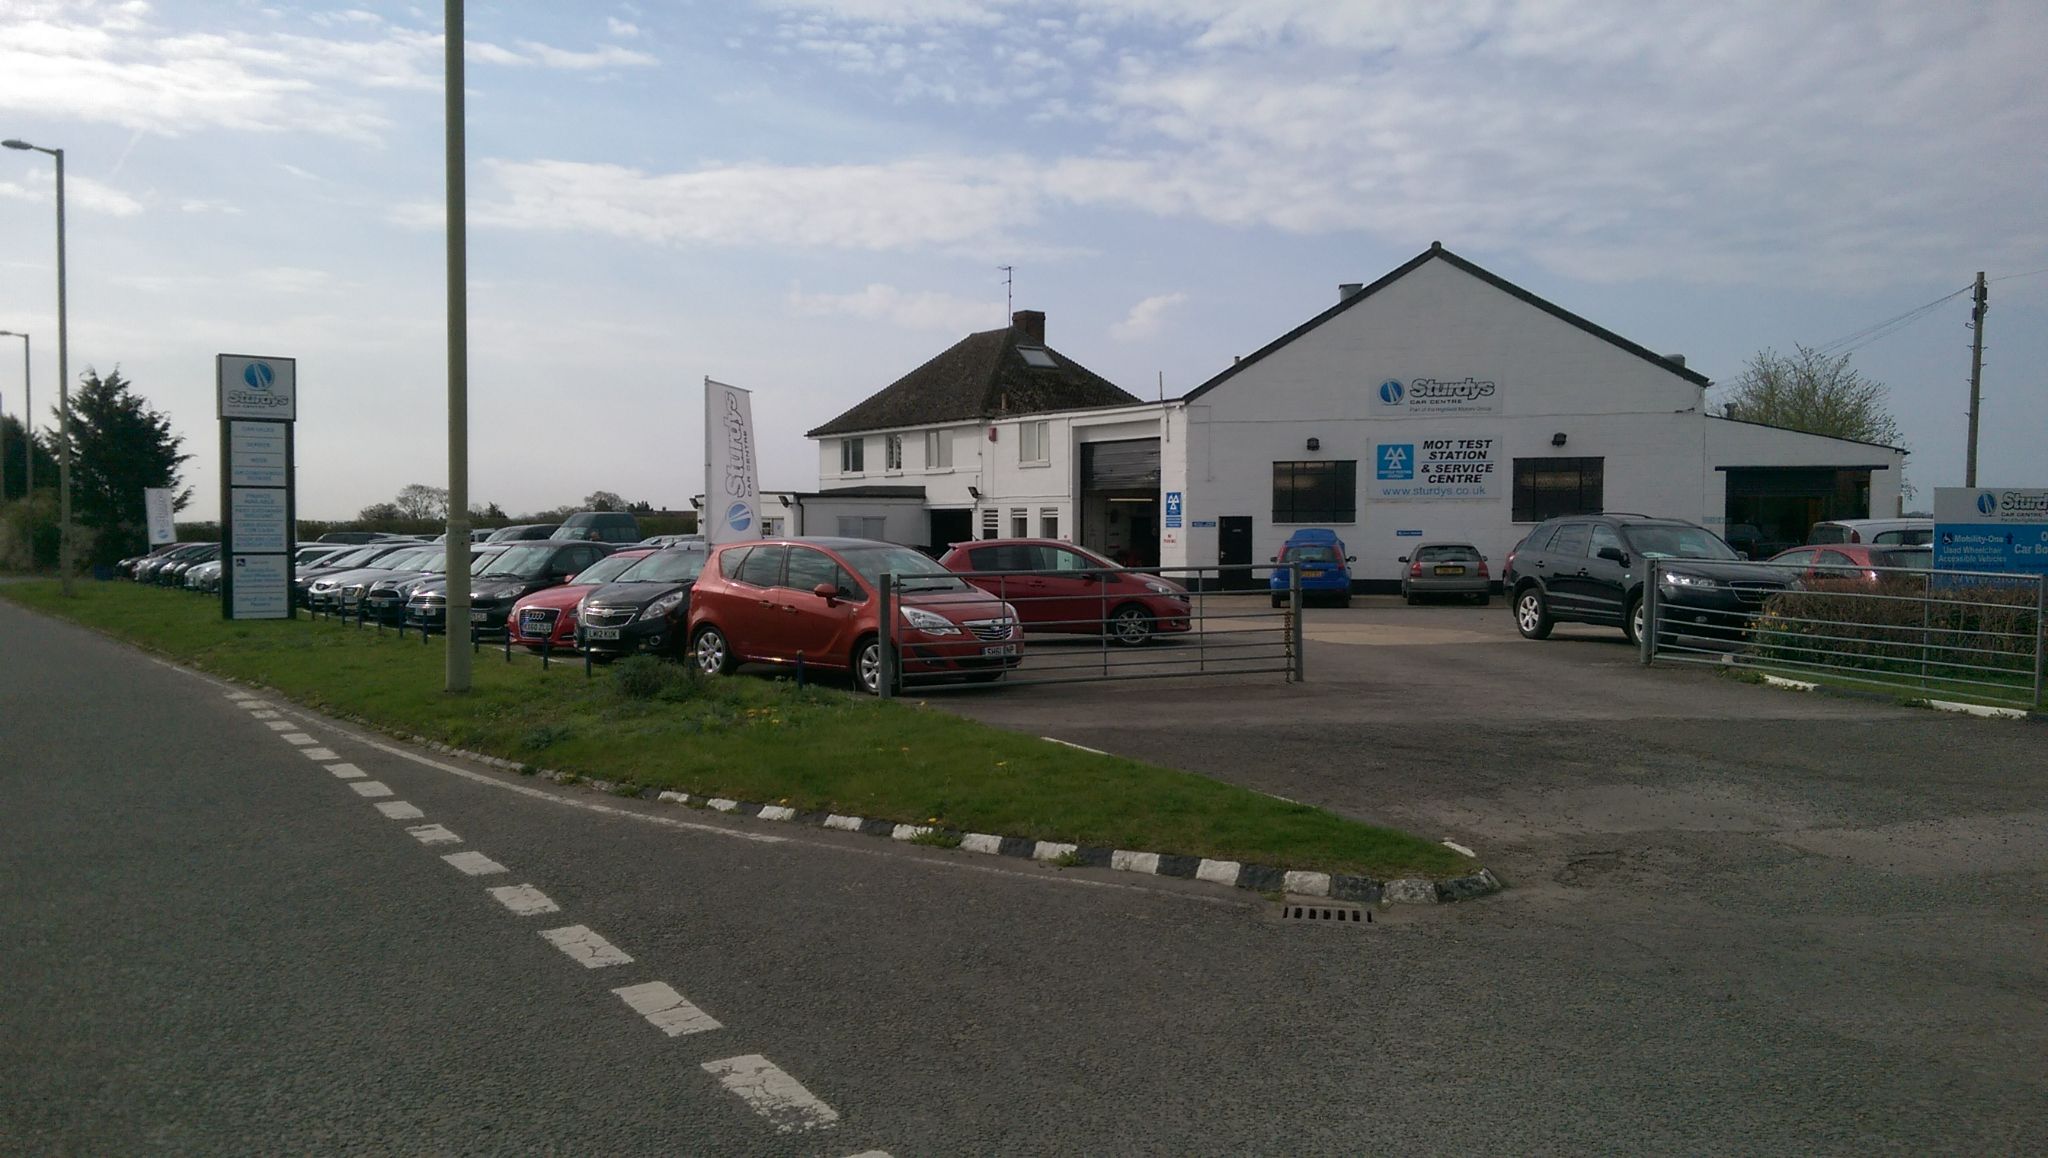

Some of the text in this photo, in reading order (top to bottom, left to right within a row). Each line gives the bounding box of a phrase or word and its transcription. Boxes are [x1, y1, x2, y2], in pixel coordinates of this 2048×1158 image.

[1409, 377, 1496, 400] Sturdys
[227, 389, 289, 408] Sturdys
[723, 390, 746, 498] Sturdys
[1422, 439, 1493, 449] MOT TEST
[743, 430, 751, 472] CENTRE
[1428, 450, 1488, 460] STATION
[1421, 463, 1494, 473] & SERVICE
[1427, 474, 1483, 483] CENTRE
[1954, 535, 2004, 545] Mobility-One
[1943, 546, 2002, 554] Used Wheelchair
[2014, 543, 2032, 554] Car
